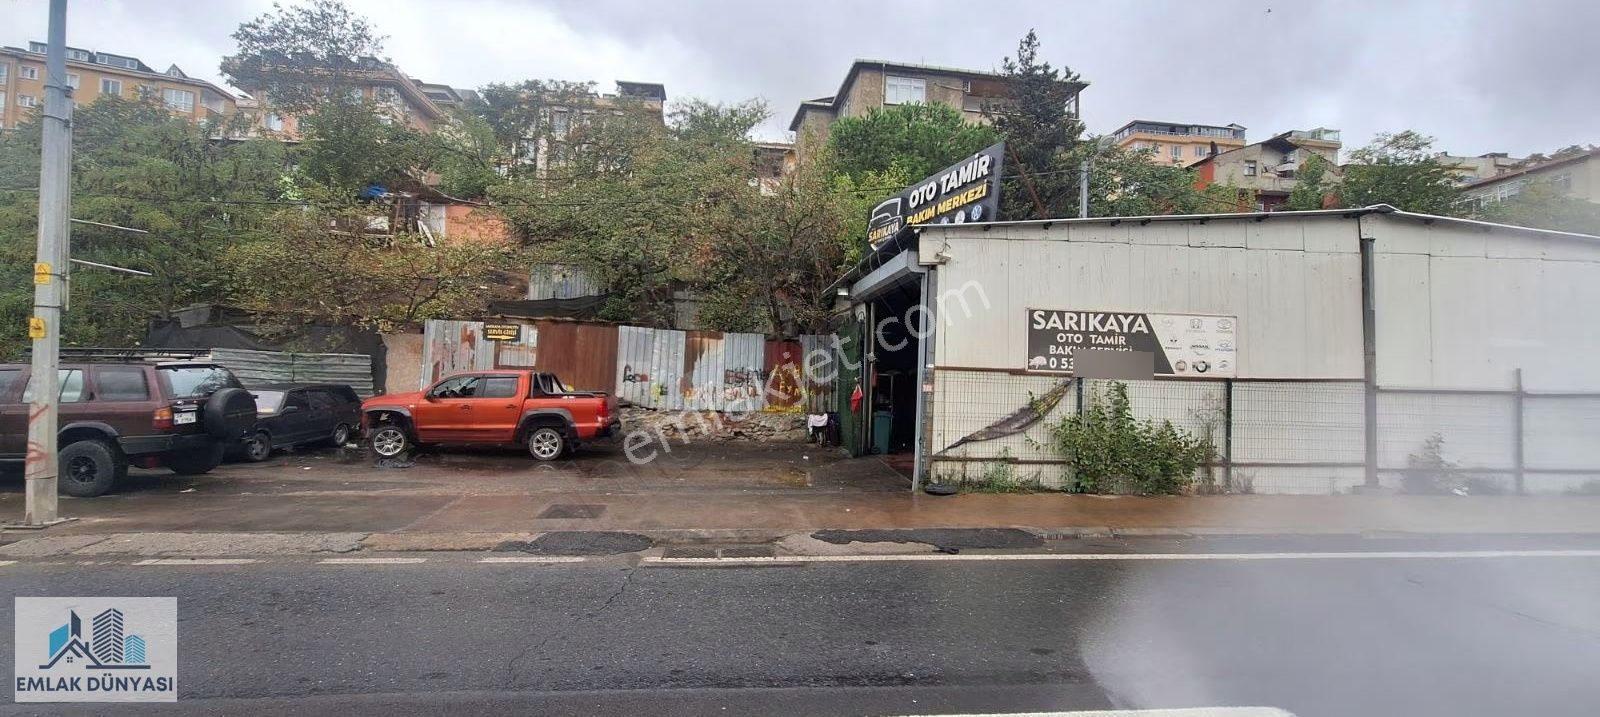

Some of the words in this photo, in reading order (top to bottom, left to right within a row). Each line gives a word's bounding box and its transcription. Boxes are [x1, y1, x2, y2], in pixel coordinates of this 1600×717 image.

[909, 181, 937, 208] OTO
[940, 153, 991, 194] TAMİR
[906, 206, 936, 225] BAKIM
[937, 180, 987, 215] MERKEZİ
[1033, 310, 1149, 334] SARIKAYA
[1049, 345, 1084, 355] BAK
[1056, 332, 1083, 344] OTO
[1089, 333, 1126, 345] TAMİR
